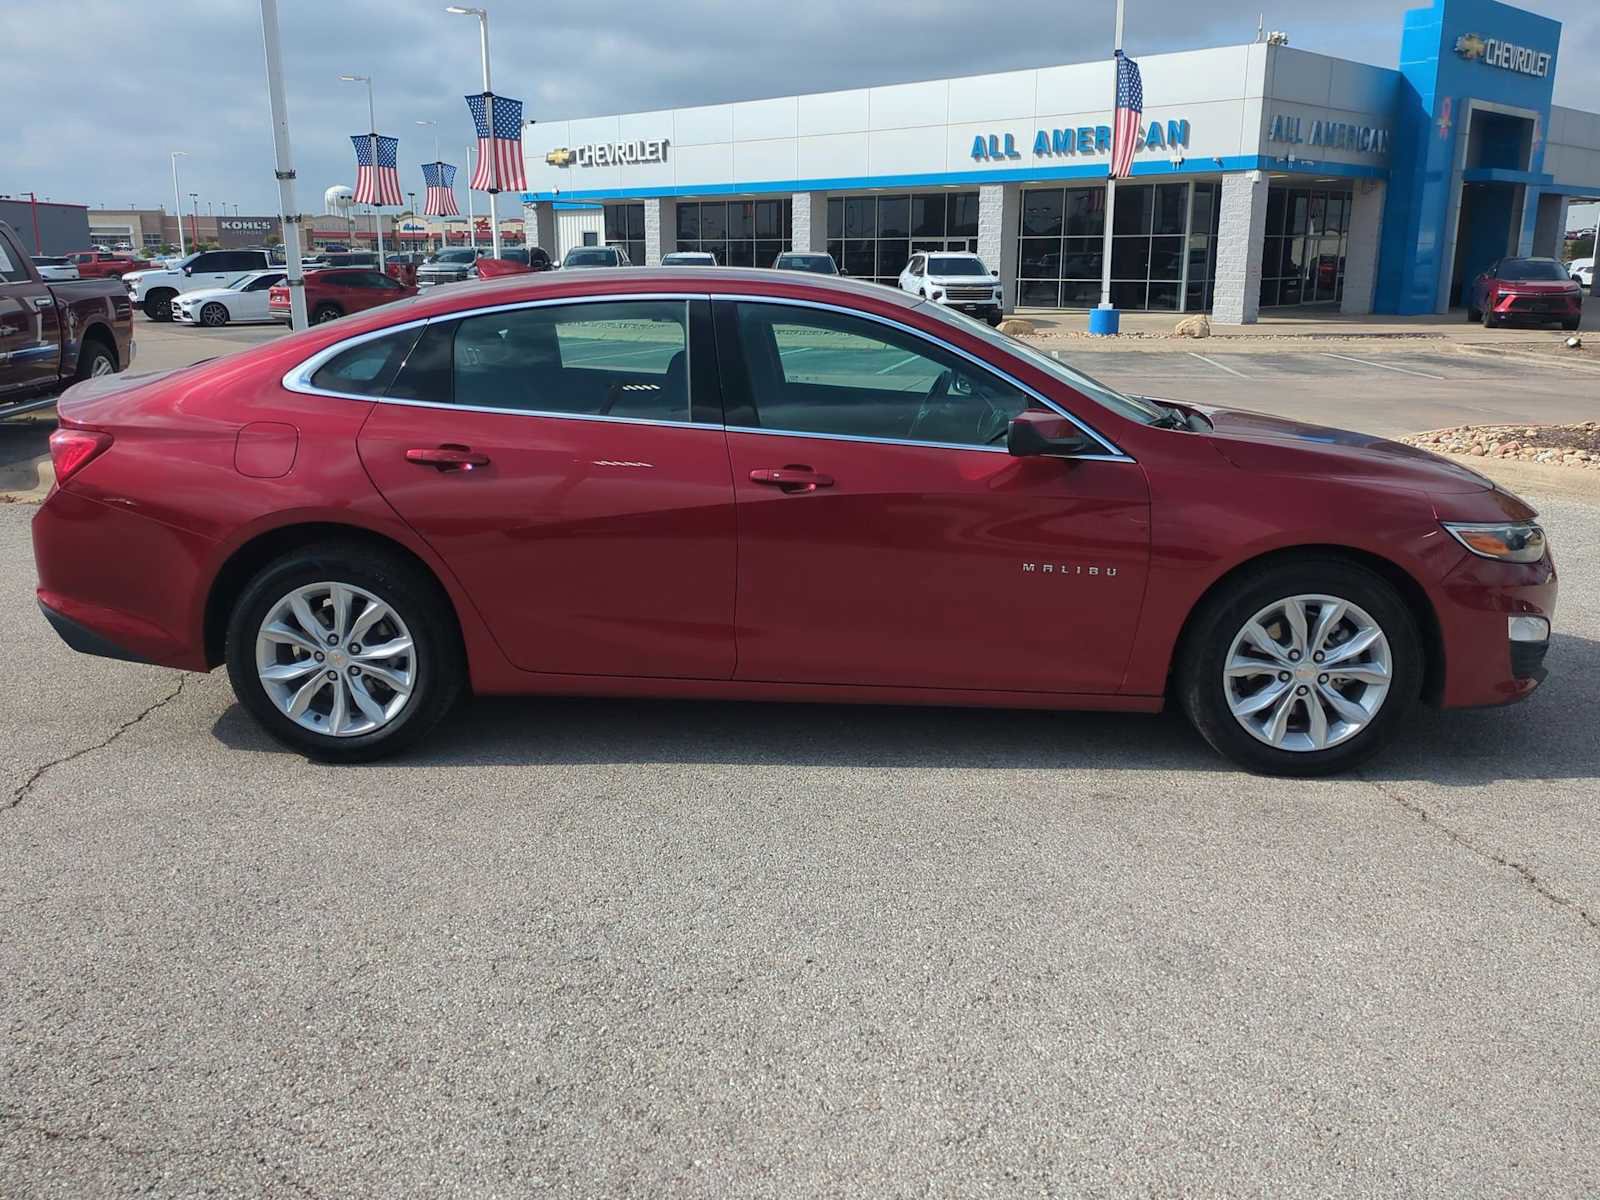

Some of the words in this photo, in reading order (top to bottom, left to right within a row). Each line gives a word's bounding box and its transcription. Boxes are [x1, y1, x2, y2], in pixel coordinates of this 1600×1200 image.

[1486, 39, 1552, 77] CHEVROLET
[971, 132, 1021, 161] ALL
[1033, 119, 1189, 157] AMERAN
[1269, 115, 1304, 144] ALL
[1309, 120, 1390, 153] AMERICAN
[576, 138, 669, 167] CHEVROLET
[221, 221, 271, 230] KOHL'S
[1022, 563, 1118, 577] MALIBU
